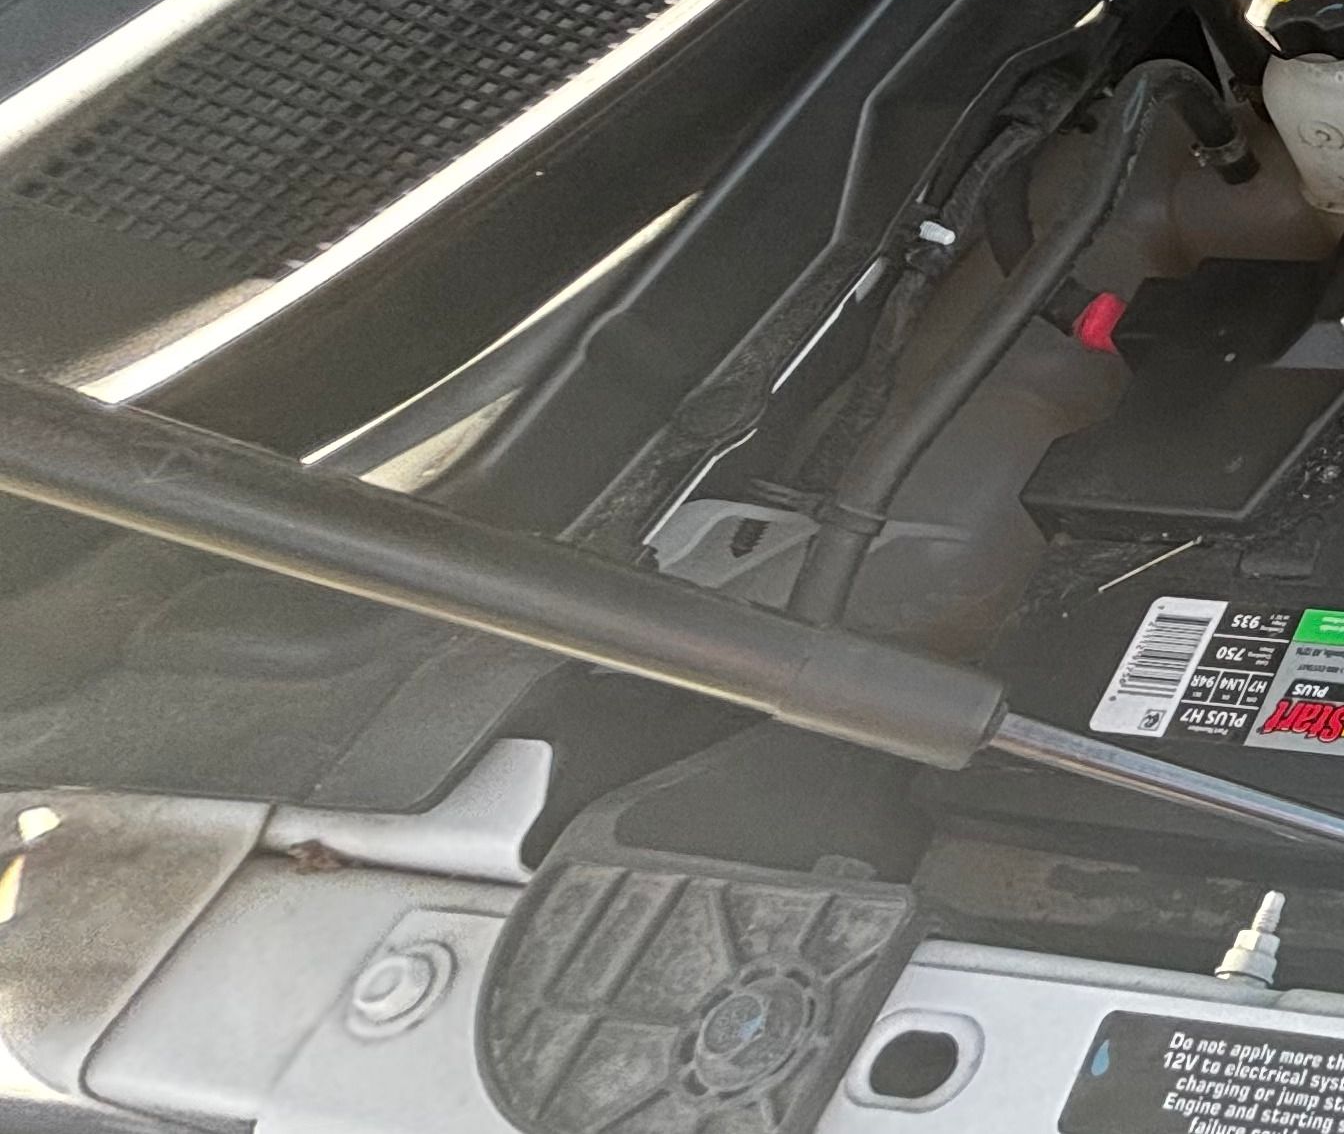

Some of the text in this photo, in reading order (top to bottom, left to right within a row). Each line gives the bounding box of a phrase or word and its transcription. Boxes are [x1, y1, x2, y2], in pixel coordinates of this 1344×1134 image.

[1231, 614, 1261, 629] 935
[1216, 646, 1246, 661] 750
[1190, 674, 1267, 693] H7 LN4 94R
[1292, 683, 1329, 697] PLUS
[1180, 708, 1247, 727] PLUS H7
[1170, 1032, 1194, 1051] Do
[1197, 1037, 1227, 1055] not
[1230, 1041, 1276, 1065] apply
[1279, 1050, 1323, 1068] more
[1163, 1051, 1200, 1072] 12V
[1201, 1056, 1223, 1075] to
[1224, 1061, 1308, 1087] electrical
[1175, 1076, 1250, 1102] charging
[1254, 1086, 1275, 1101] or
[1277, 1087, 1320, 1109] jump
[1162, 1092, 1220, 1117] Engine
[1224, 1102, 1257, 1121] and
[1260, 1108, 1334, 1133] starting
[1188, 1116, 1249, 1134] failure
